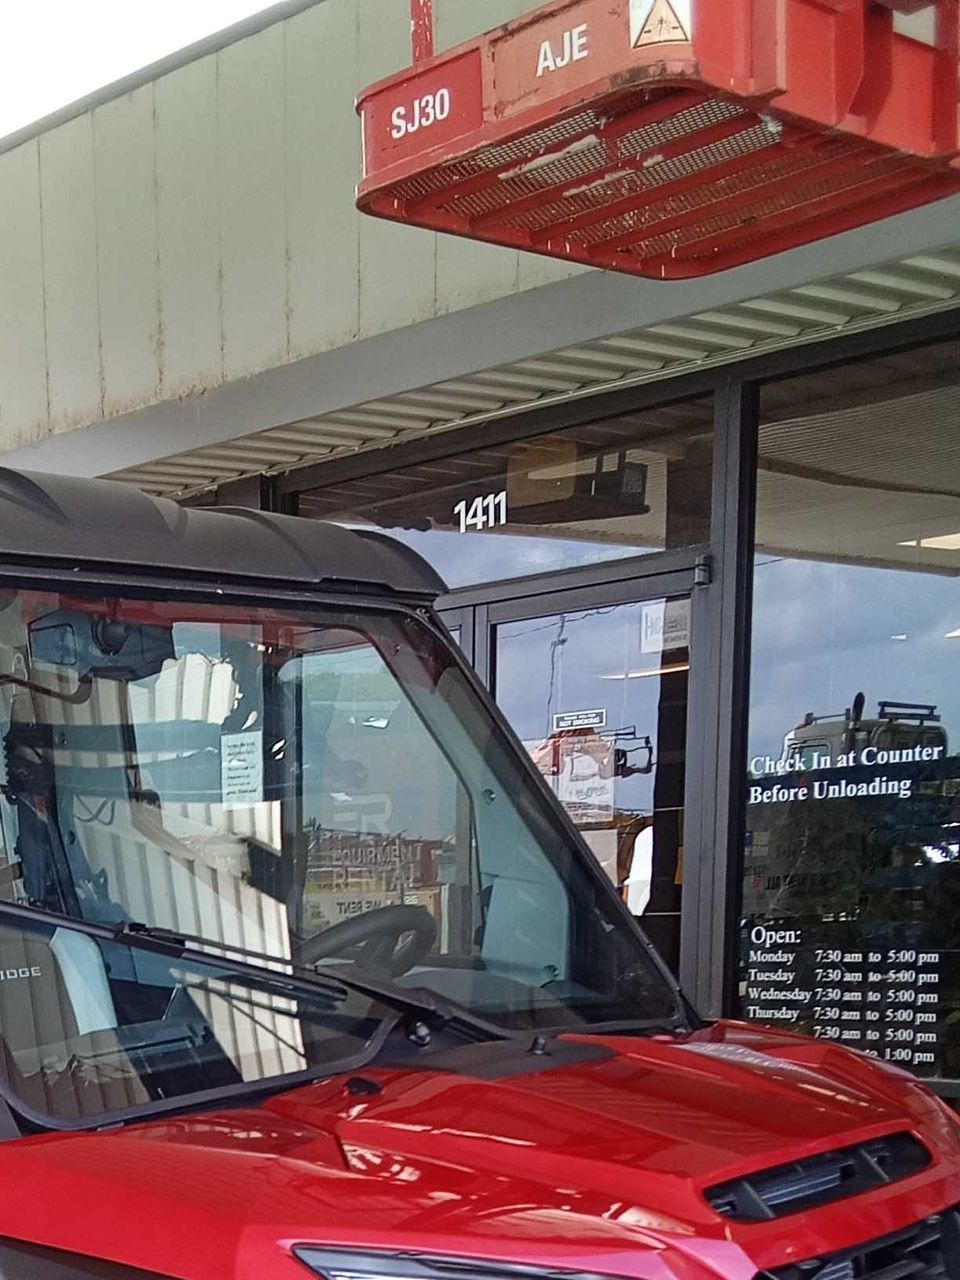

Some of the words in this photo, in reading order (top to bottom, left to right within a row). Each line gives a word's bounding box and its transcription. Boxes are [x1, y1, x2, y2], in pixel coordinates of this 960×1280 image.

[535, 23, 589, 78] AJE
[390, 88, 451, 139] SJ30
[453, 491, 508, 534] 1411
[750, 753, 806, 775] Check
[811, 751, 830, 770] In
[837, 750, 856, 768] at
[861, 745, 944, 766] Counter
[749, 785, 808, 805] Before
[813, 777, 912, 800] Unloading
[751, 927, 801, 947] Open:
[749, 950, 795, 964] Monday
[815, 950, 841, 963] 7:30
[843, 952, 862, 962] am
[868, 952, 882, 962] to
[886, 950, 916, 963] 5:00
[918, 953, 939, 966] pm
[748, 969, 796, 984] Tuesday
[814, 969, 841, 982] 7:30
[843, 971, 862, 982] am
[868, 971, 882, 982] to
[886, 969, 916, 982] 5:00
[918, 972, 939, 985] pm
[748, 988, 812, 1003] Wednesday
[815, 988, 840, 1000] 7:30
[842, 990, 862, 1001] am
[867, 990, 881, 1001] to
[886, 988, 915, 1002] 5:00
[916, 992, 938, 1005] pm
[747, 1006, 800, 1021] Thursday
[813, 1007, 840, 1019] 7:30
[841, 1010, 860, 1020] am
[866, 1009, 880, 1020] to
[884, 1008, 914, 1022] 5:00
[915, 1012, 937, 1025] pm
[813, 1026, 840, 1039] 7:30
[841, 1029, 860, 1040] am
[866, 1028, 880, 1040] to
[884, 1028, 914, 1042] 5:00
[915, 1031, 937, 1045] pm
[885, 1048, 912, 1061] 1:00
[913, 1051, 934, 1064] pm
